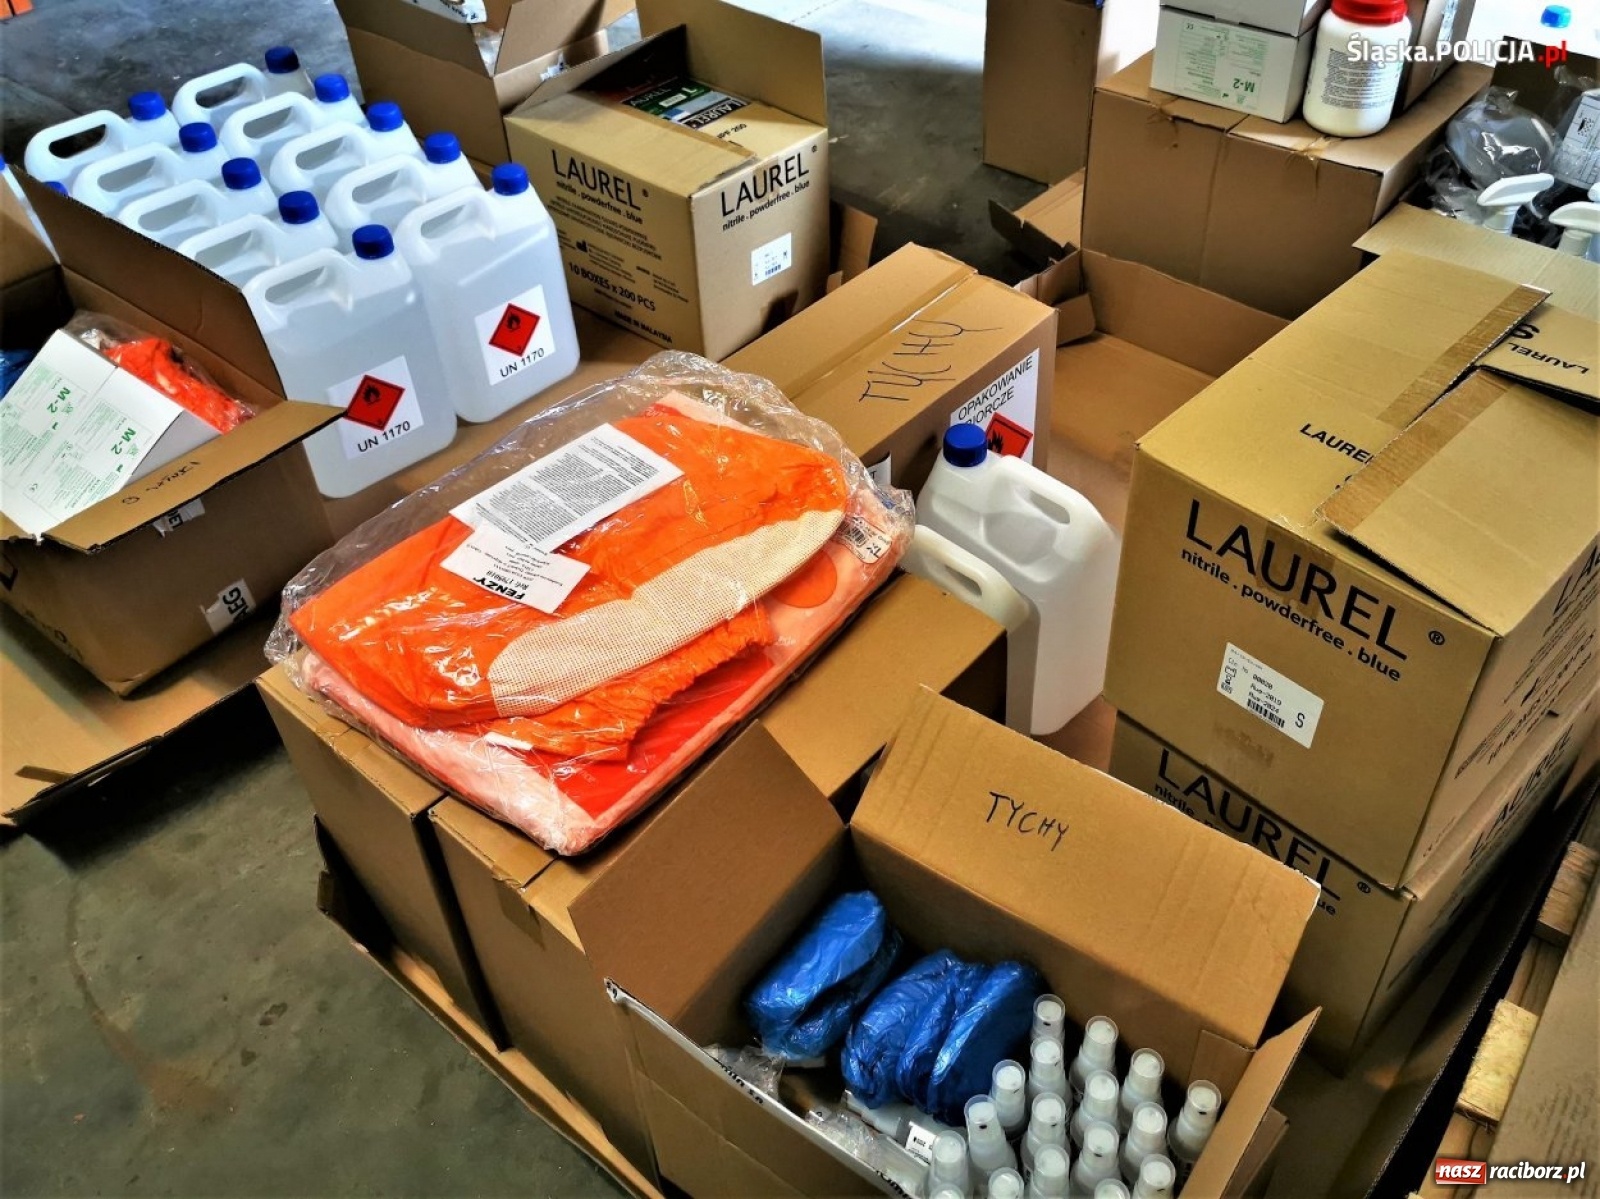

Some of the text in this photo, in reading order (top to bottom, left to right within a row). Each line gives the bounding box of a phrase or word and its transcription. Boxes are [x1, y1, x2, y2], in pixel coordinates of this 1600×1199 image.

[1233, 78, 1256, 93] M-2
[551, 149, 641, 211] LAUREL
[721, 152, 810, 217] LAUREL
[557, 181, 643, 225] nitrile powderfree blue
[722, 180, 810, 231] nitrile powderfree blue
[569, 262, 580, 276] 10
[580, 266, 610, 290] BOXES
[618, 286, 636, 302] 200
[637, 294, 656, 312] PCS
[499, 346, 545, 379] UN 1170
[1508, 342, 1589, 375] LAUREL
[46, 386, 71, 414] M-2
[958, 355, 1033, 421] OPAKOWANIE
[110, 426, 137, 455] M-2
[357, 420, 411, 453] UN 1170
[474, 575, 526, 601] FENZY
[1185, 498, 1407, 660] LAUREL
[1180, 547, 1400, 682] nitrile powderfree blue
[1295, 712, 1305, 728] S
[987, 791, 1069, 851] TYCHY
